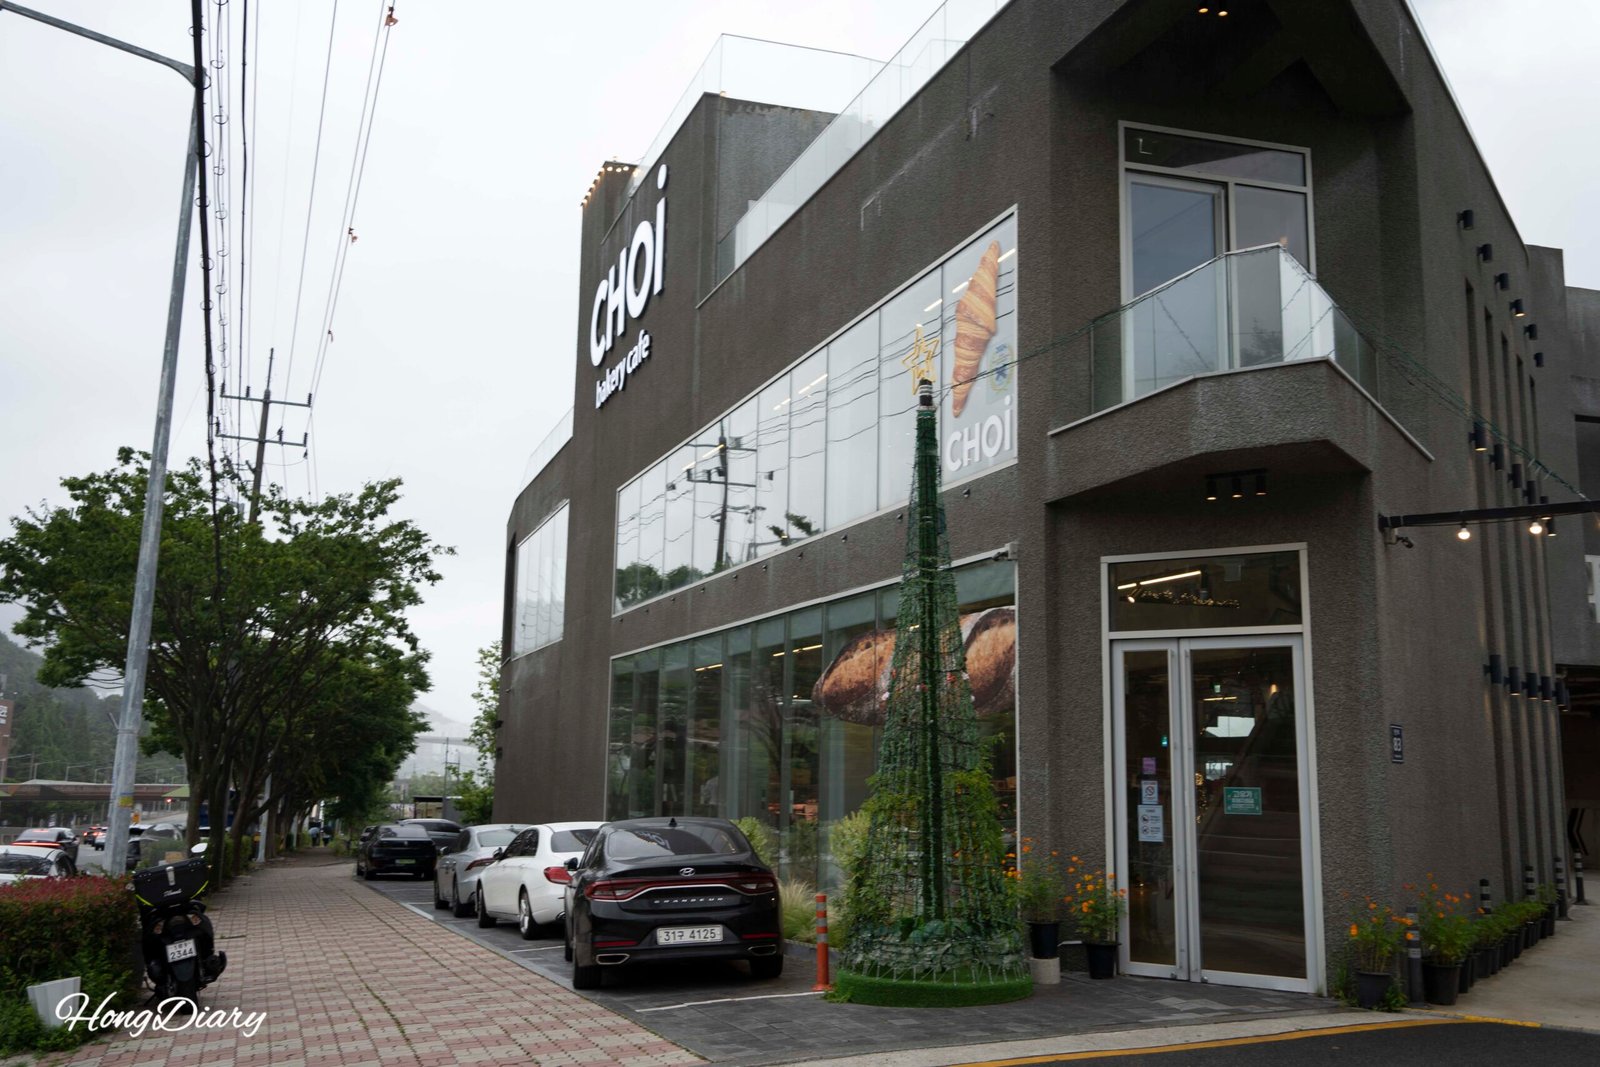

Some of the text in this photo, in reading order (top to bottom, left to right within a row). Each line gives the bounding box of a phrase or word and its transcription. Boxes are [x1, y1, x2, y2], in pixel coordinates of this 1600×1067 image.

[595, 329, 652, 409] bakery cafe
[689, 928, 717, 940] 4125
[170, 947, 193, 960] 2344
